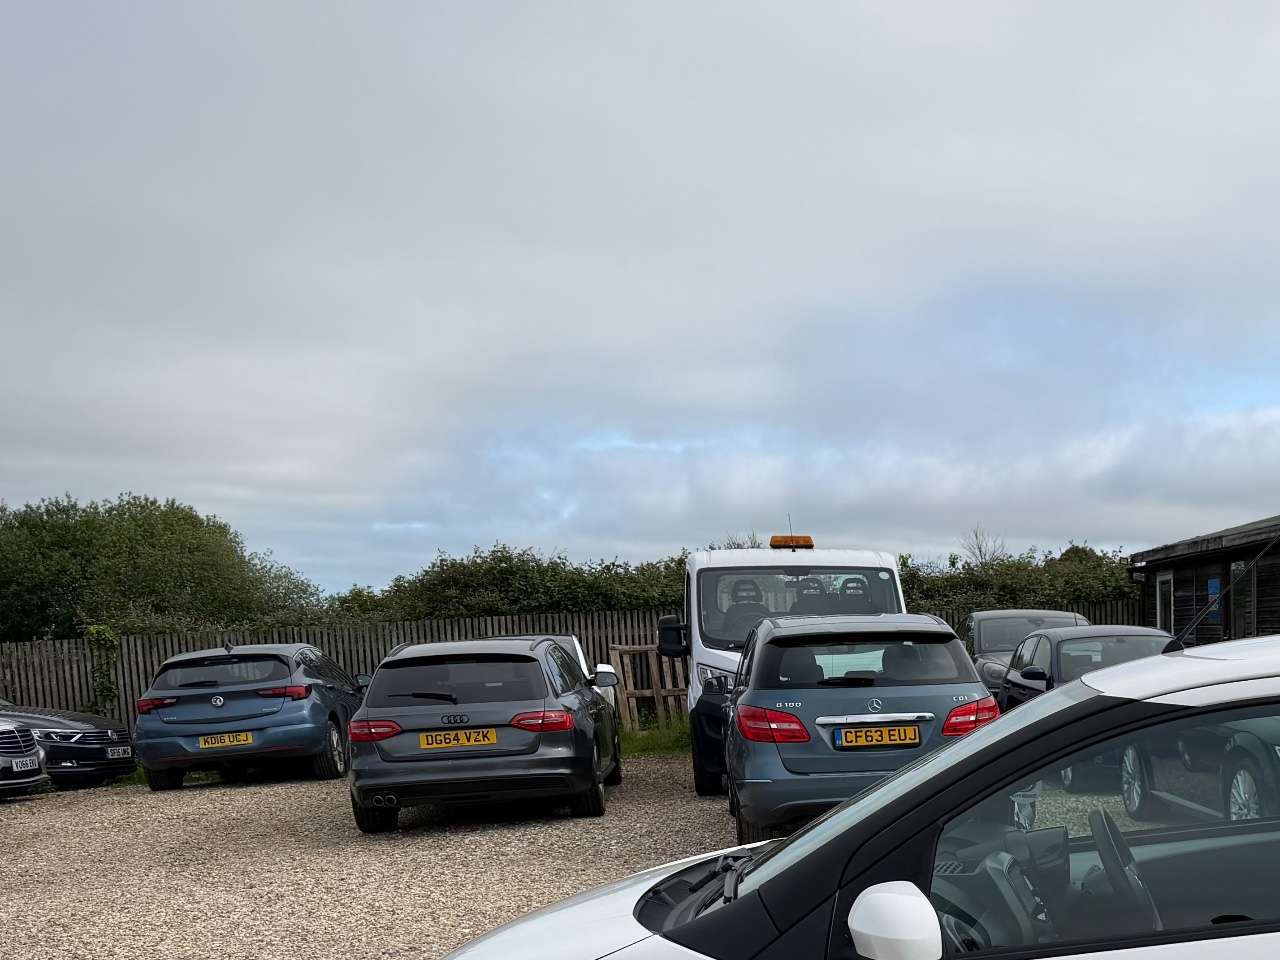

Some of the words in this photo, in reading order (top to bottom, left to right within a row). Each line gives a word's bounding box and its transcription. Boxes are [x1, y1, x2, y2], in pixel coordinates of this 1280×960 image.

[203, 735, 226, 746] KD16
[425, 732, 461, 746] DG64
[464, 730, 491, 743] VZK
[844, 730, 884, 744] CF63
[888, 727, 918, 742] EUJ
